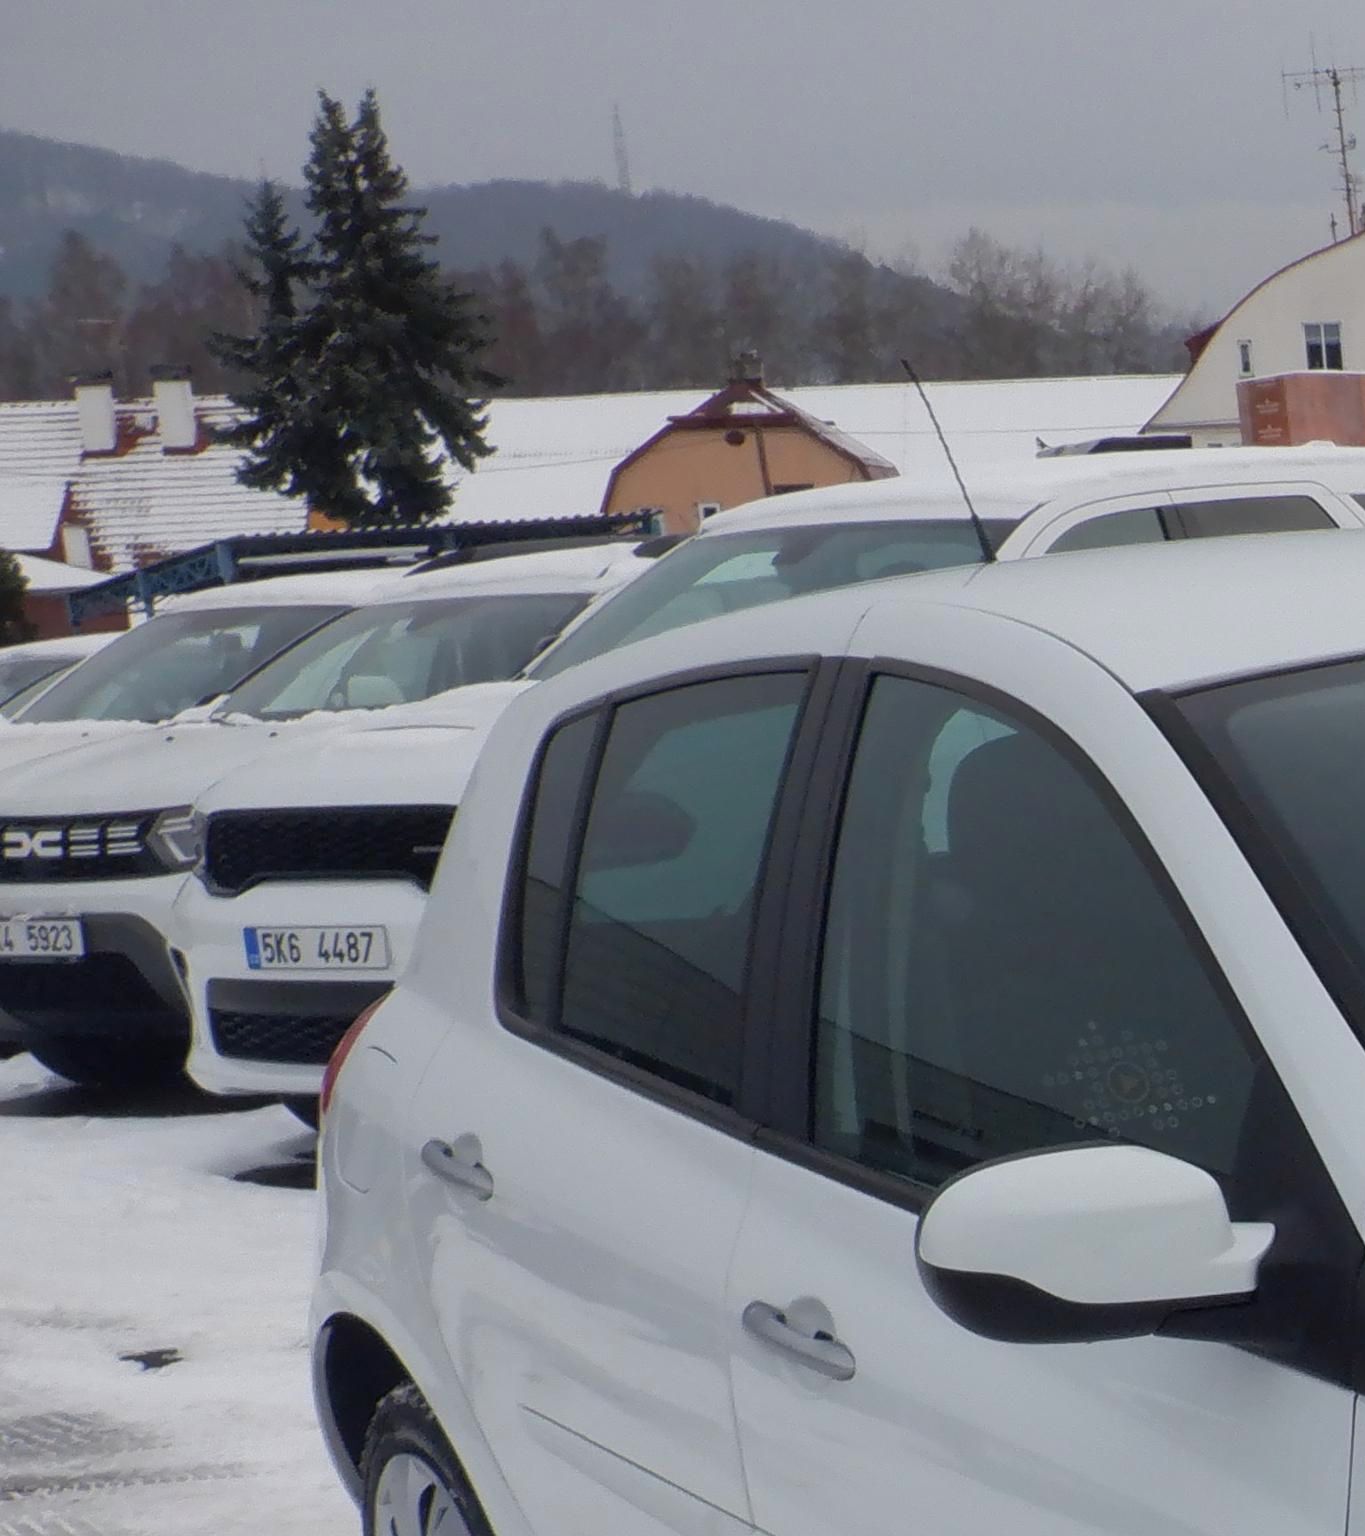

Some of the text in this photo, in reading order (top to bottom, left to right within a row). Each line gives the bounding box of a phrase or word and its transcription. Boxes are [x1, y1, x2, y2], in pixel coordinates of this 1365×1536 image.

[27, 925, 73, 952] 5923
[262, 931, 373, 963] 5K6 4487
